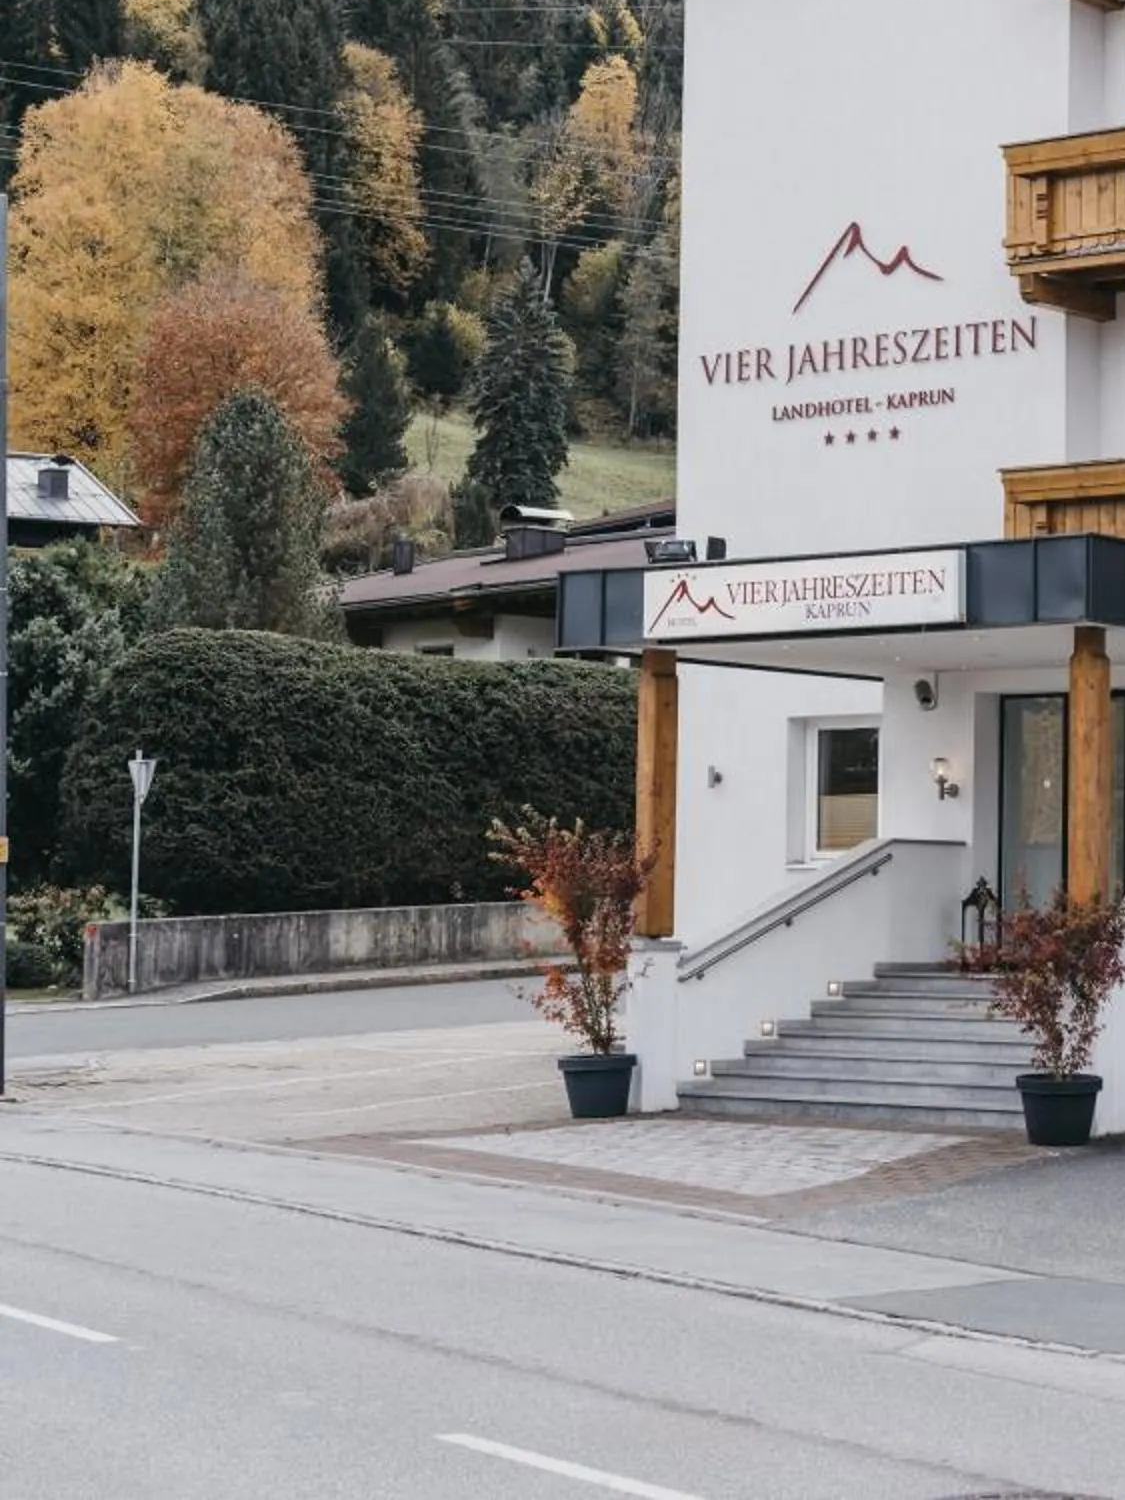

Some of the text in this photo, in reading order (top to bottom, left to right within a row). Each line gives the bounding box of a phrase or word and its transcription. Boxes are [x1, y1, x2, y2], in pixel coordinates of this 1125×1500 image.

[700, 315, 1038, 386] VIER JAHRESZEITEN
[772, 396, 872, 422] LANDHOTEL
[886, 387, 956, 411] KAPRUN
[726, 568, 947, 608] VIER JAHRESZEITEN
[805, 600, 871, 621] KAPRUN
